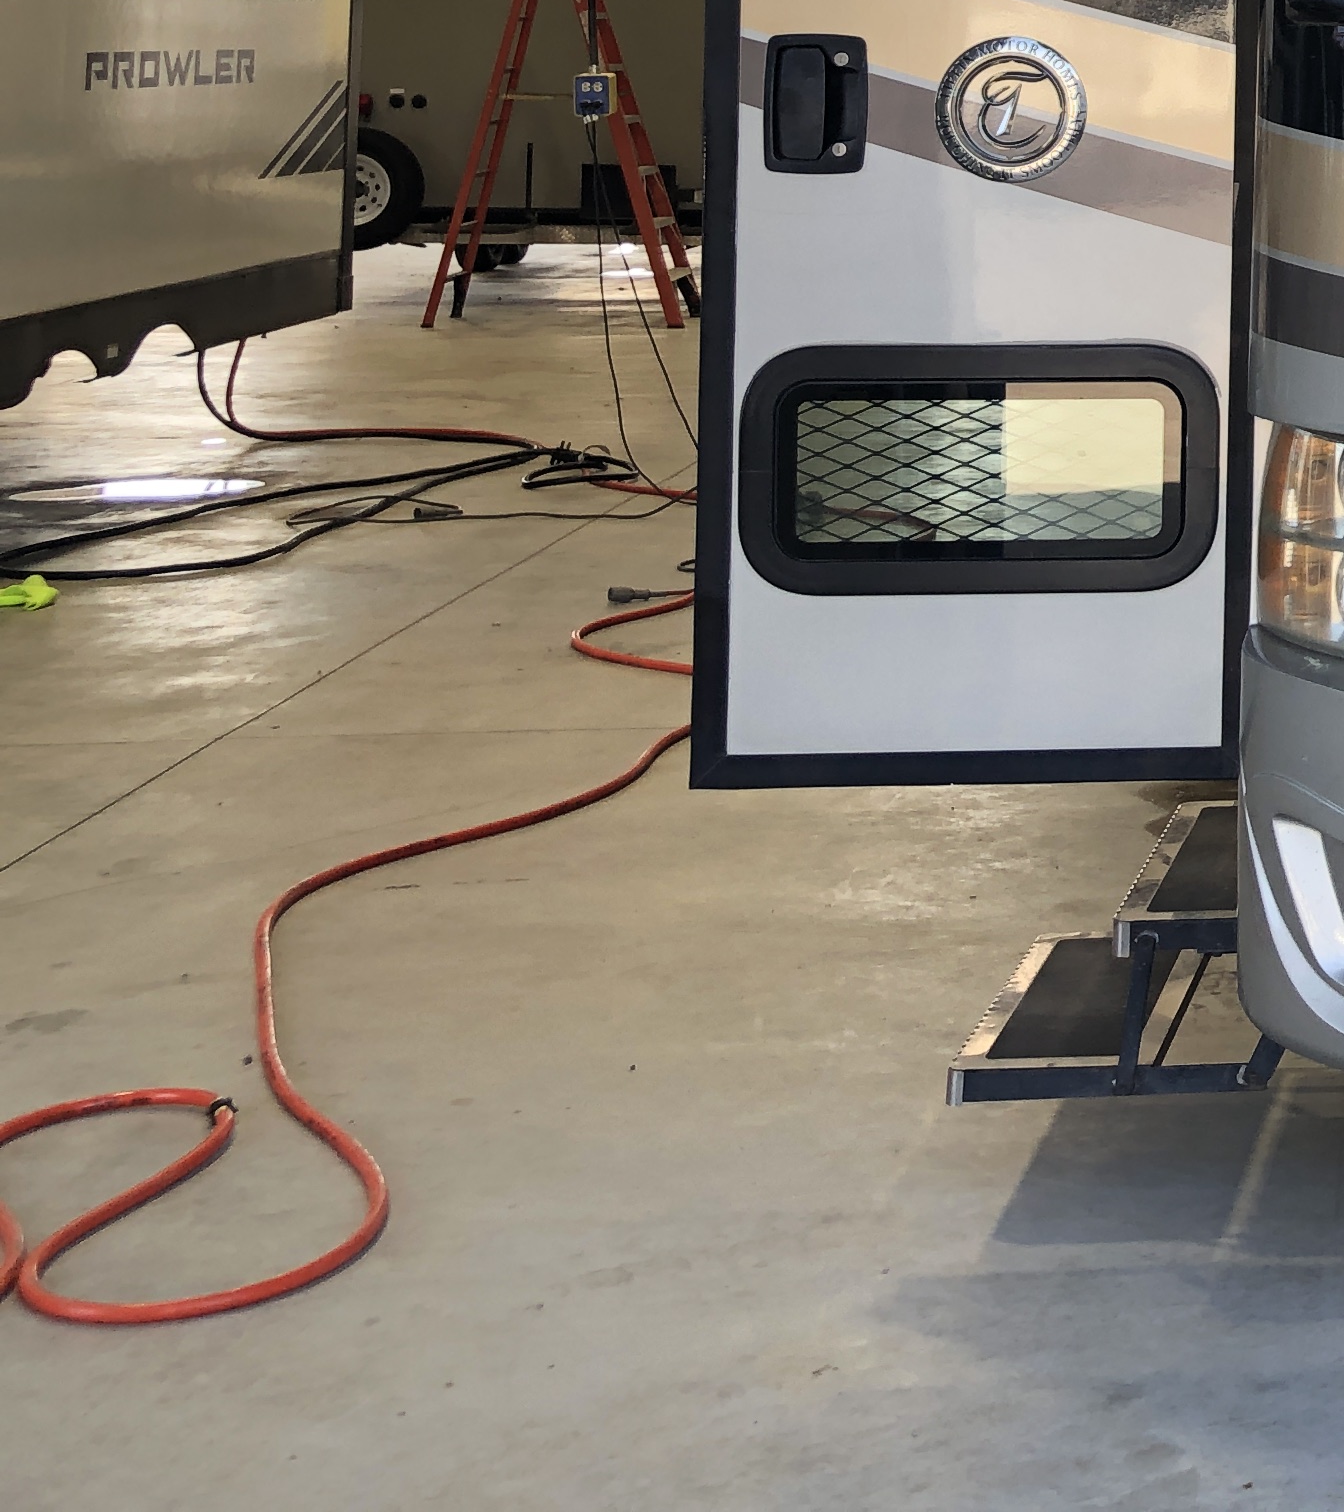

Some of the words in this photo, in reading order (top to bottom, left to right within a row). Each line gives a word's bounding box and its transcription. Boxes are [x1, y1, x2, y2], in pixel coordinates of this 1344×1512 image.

[84, 49, 255, 91] PROWLER
[976, 39, 1040, 58] MOTOR
[1043, 47, 1082, 102] HOMES
